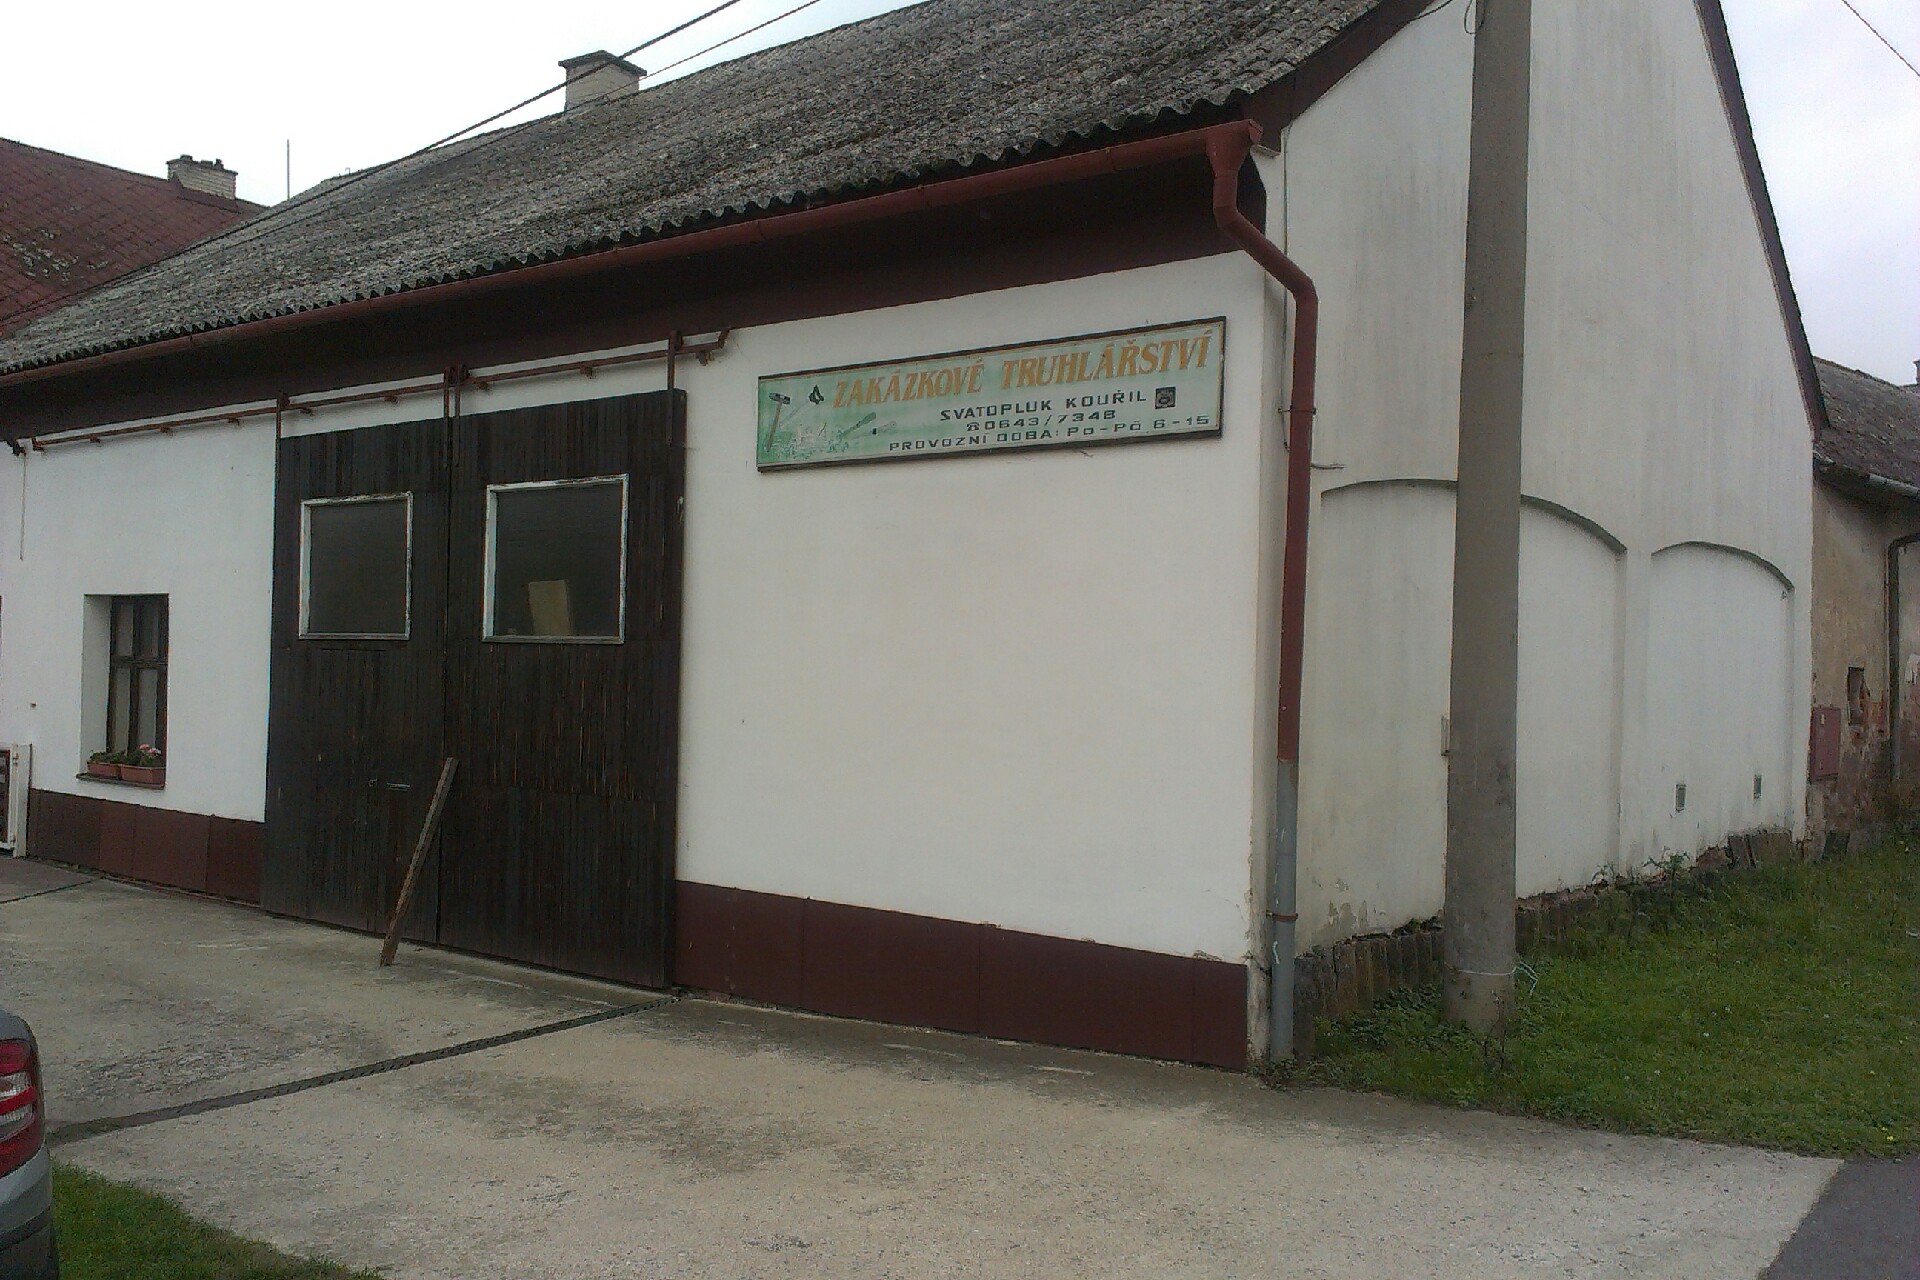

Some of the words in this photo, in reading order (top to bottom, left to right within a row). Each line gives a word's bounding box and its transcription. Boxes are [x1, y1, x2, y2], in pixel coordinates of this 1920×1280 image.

[832, 356, 985, 408] ZAKÁZKOVÉ
[1001, 329, 1212, 390] TRUHLÁŘSTVÍ
[939, 399, 1052, 421] SVATOPLUK
[1066, 389, 1147, 409] KOUŘIL
[889, 432, 988, 451] PROVOZNÍ
